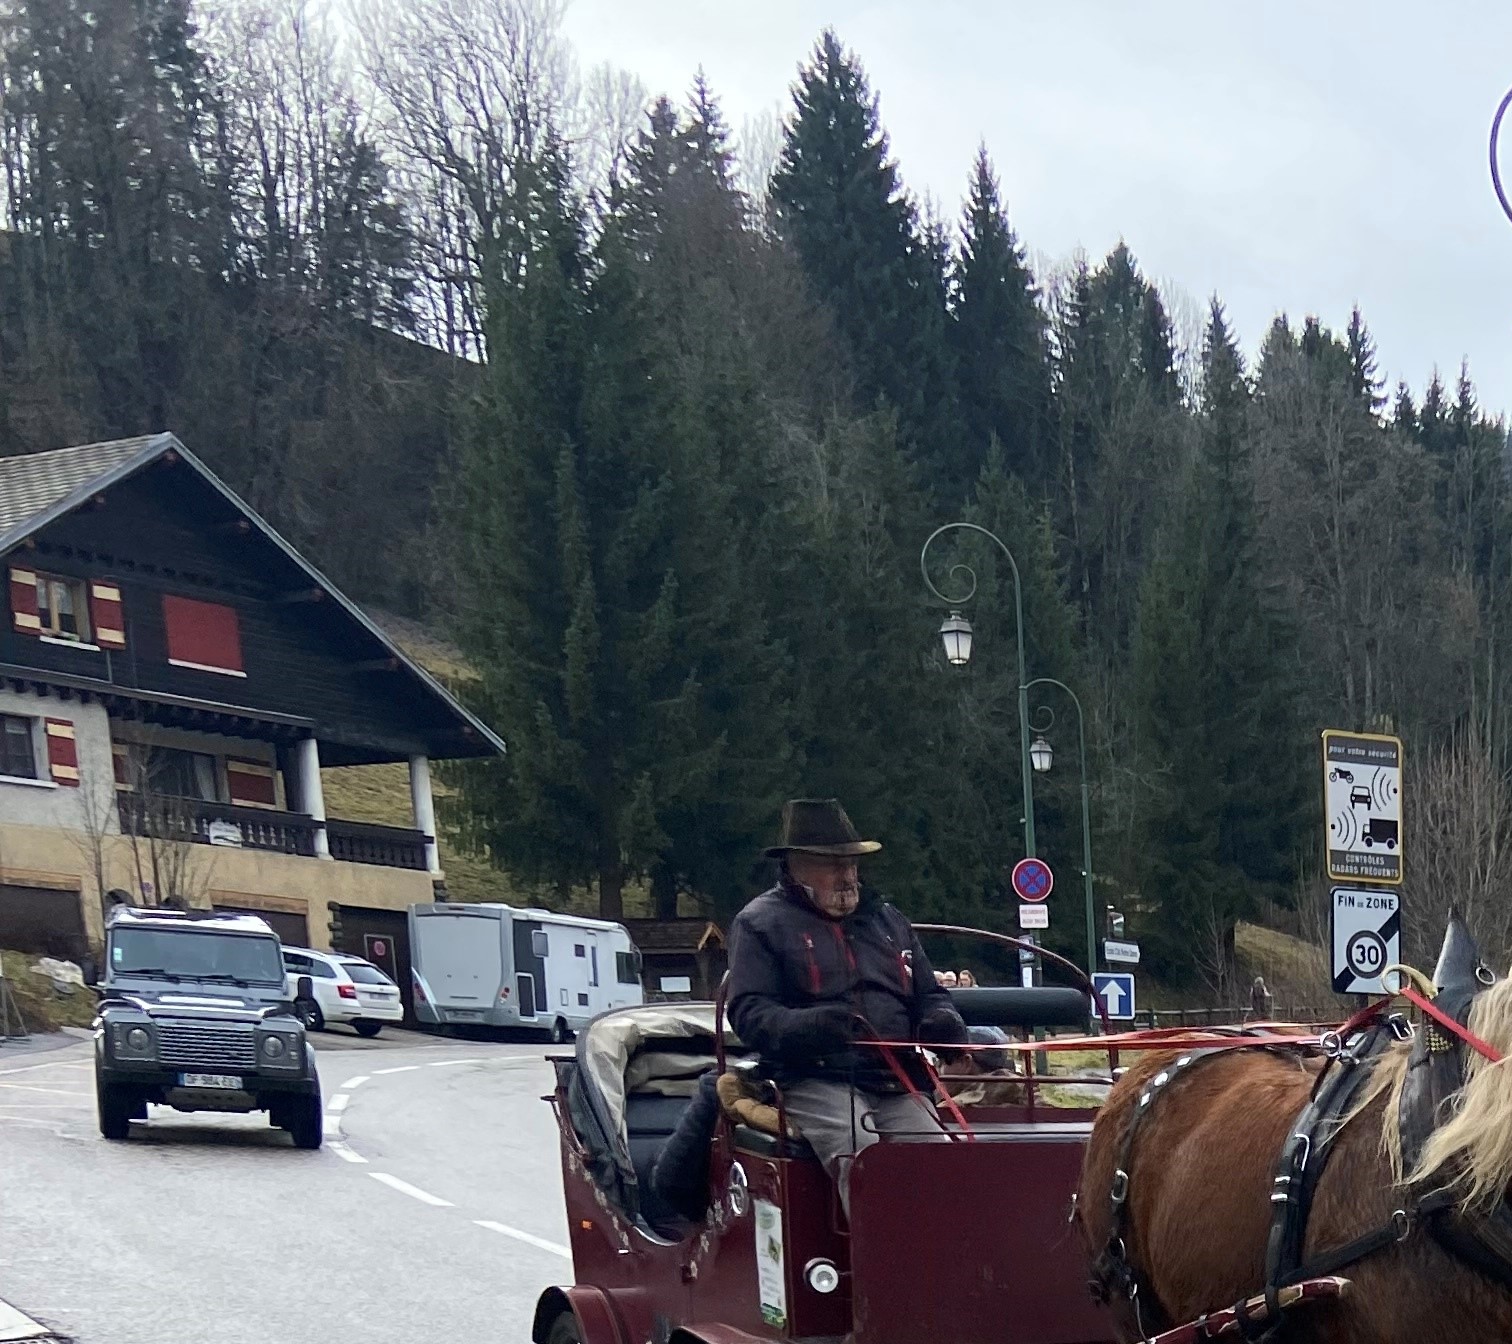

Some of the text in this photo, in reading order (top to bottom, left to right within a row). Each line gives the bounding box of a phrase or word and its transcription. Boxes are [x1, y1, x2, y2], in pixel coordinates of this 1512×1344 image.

[1345, 853, 1385, 866] CONTRÔLES
[1331, 863, 1399, 878] RADARS FRÉQUENTS
[1338, 895, 1355, 907] FIN
[1366, 897, 1395, 911] ZONE
[1355, 944, 1379, 965] 30
